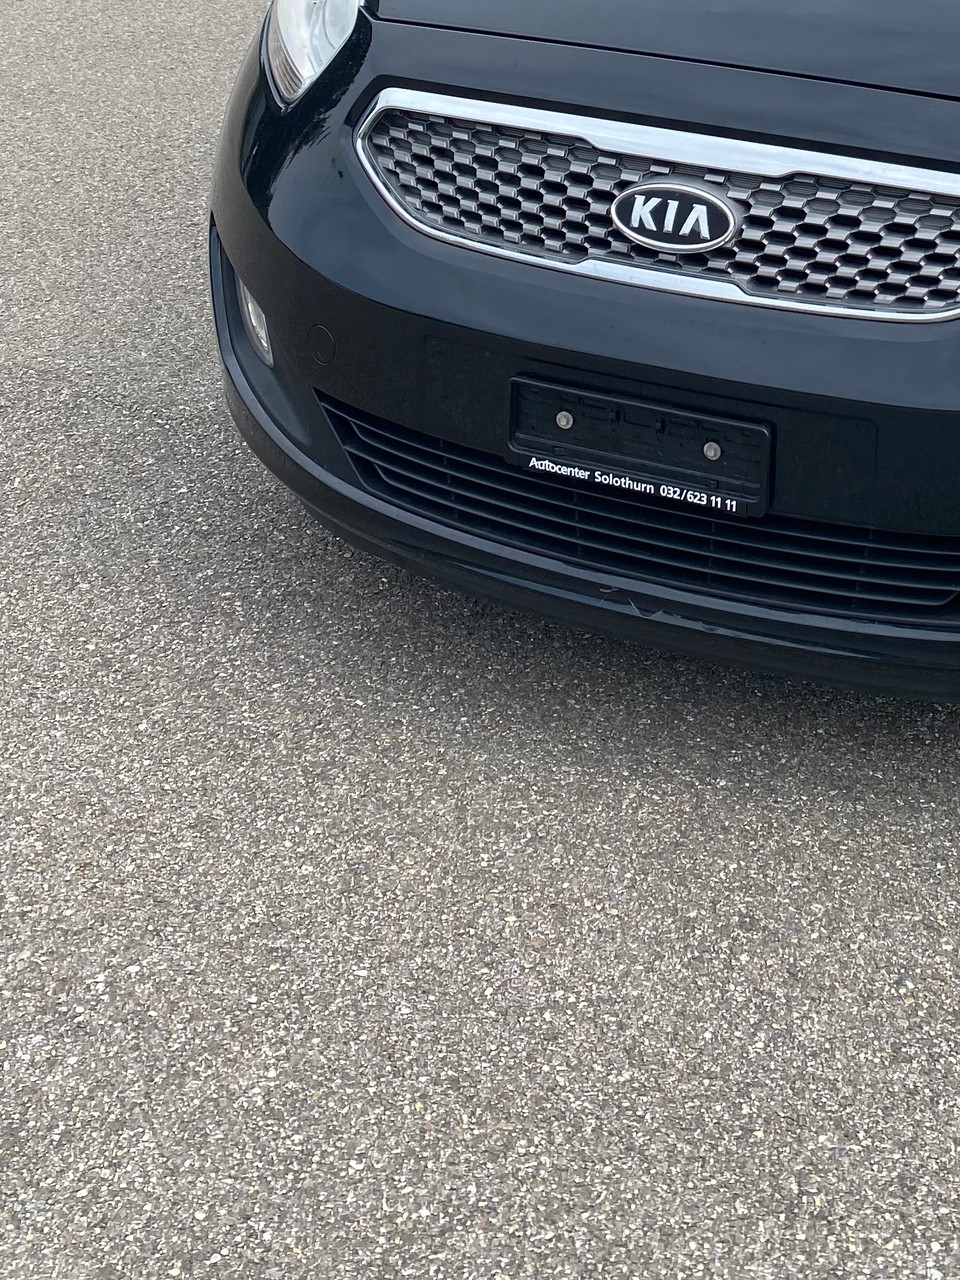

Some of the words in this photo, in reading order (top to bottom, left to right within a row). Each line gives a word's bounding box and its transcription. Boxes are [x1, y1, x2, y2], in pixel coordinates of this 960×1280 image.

[630, 195, 710, 240] KIA
[529, 457, 590, 480] Autocenter
[594, 471, 655, 494] Solothurn
[660, 485, 708, 506] 032/623
[709, 496, 722, 509] 11
[725, 499, 737, 512] 11
